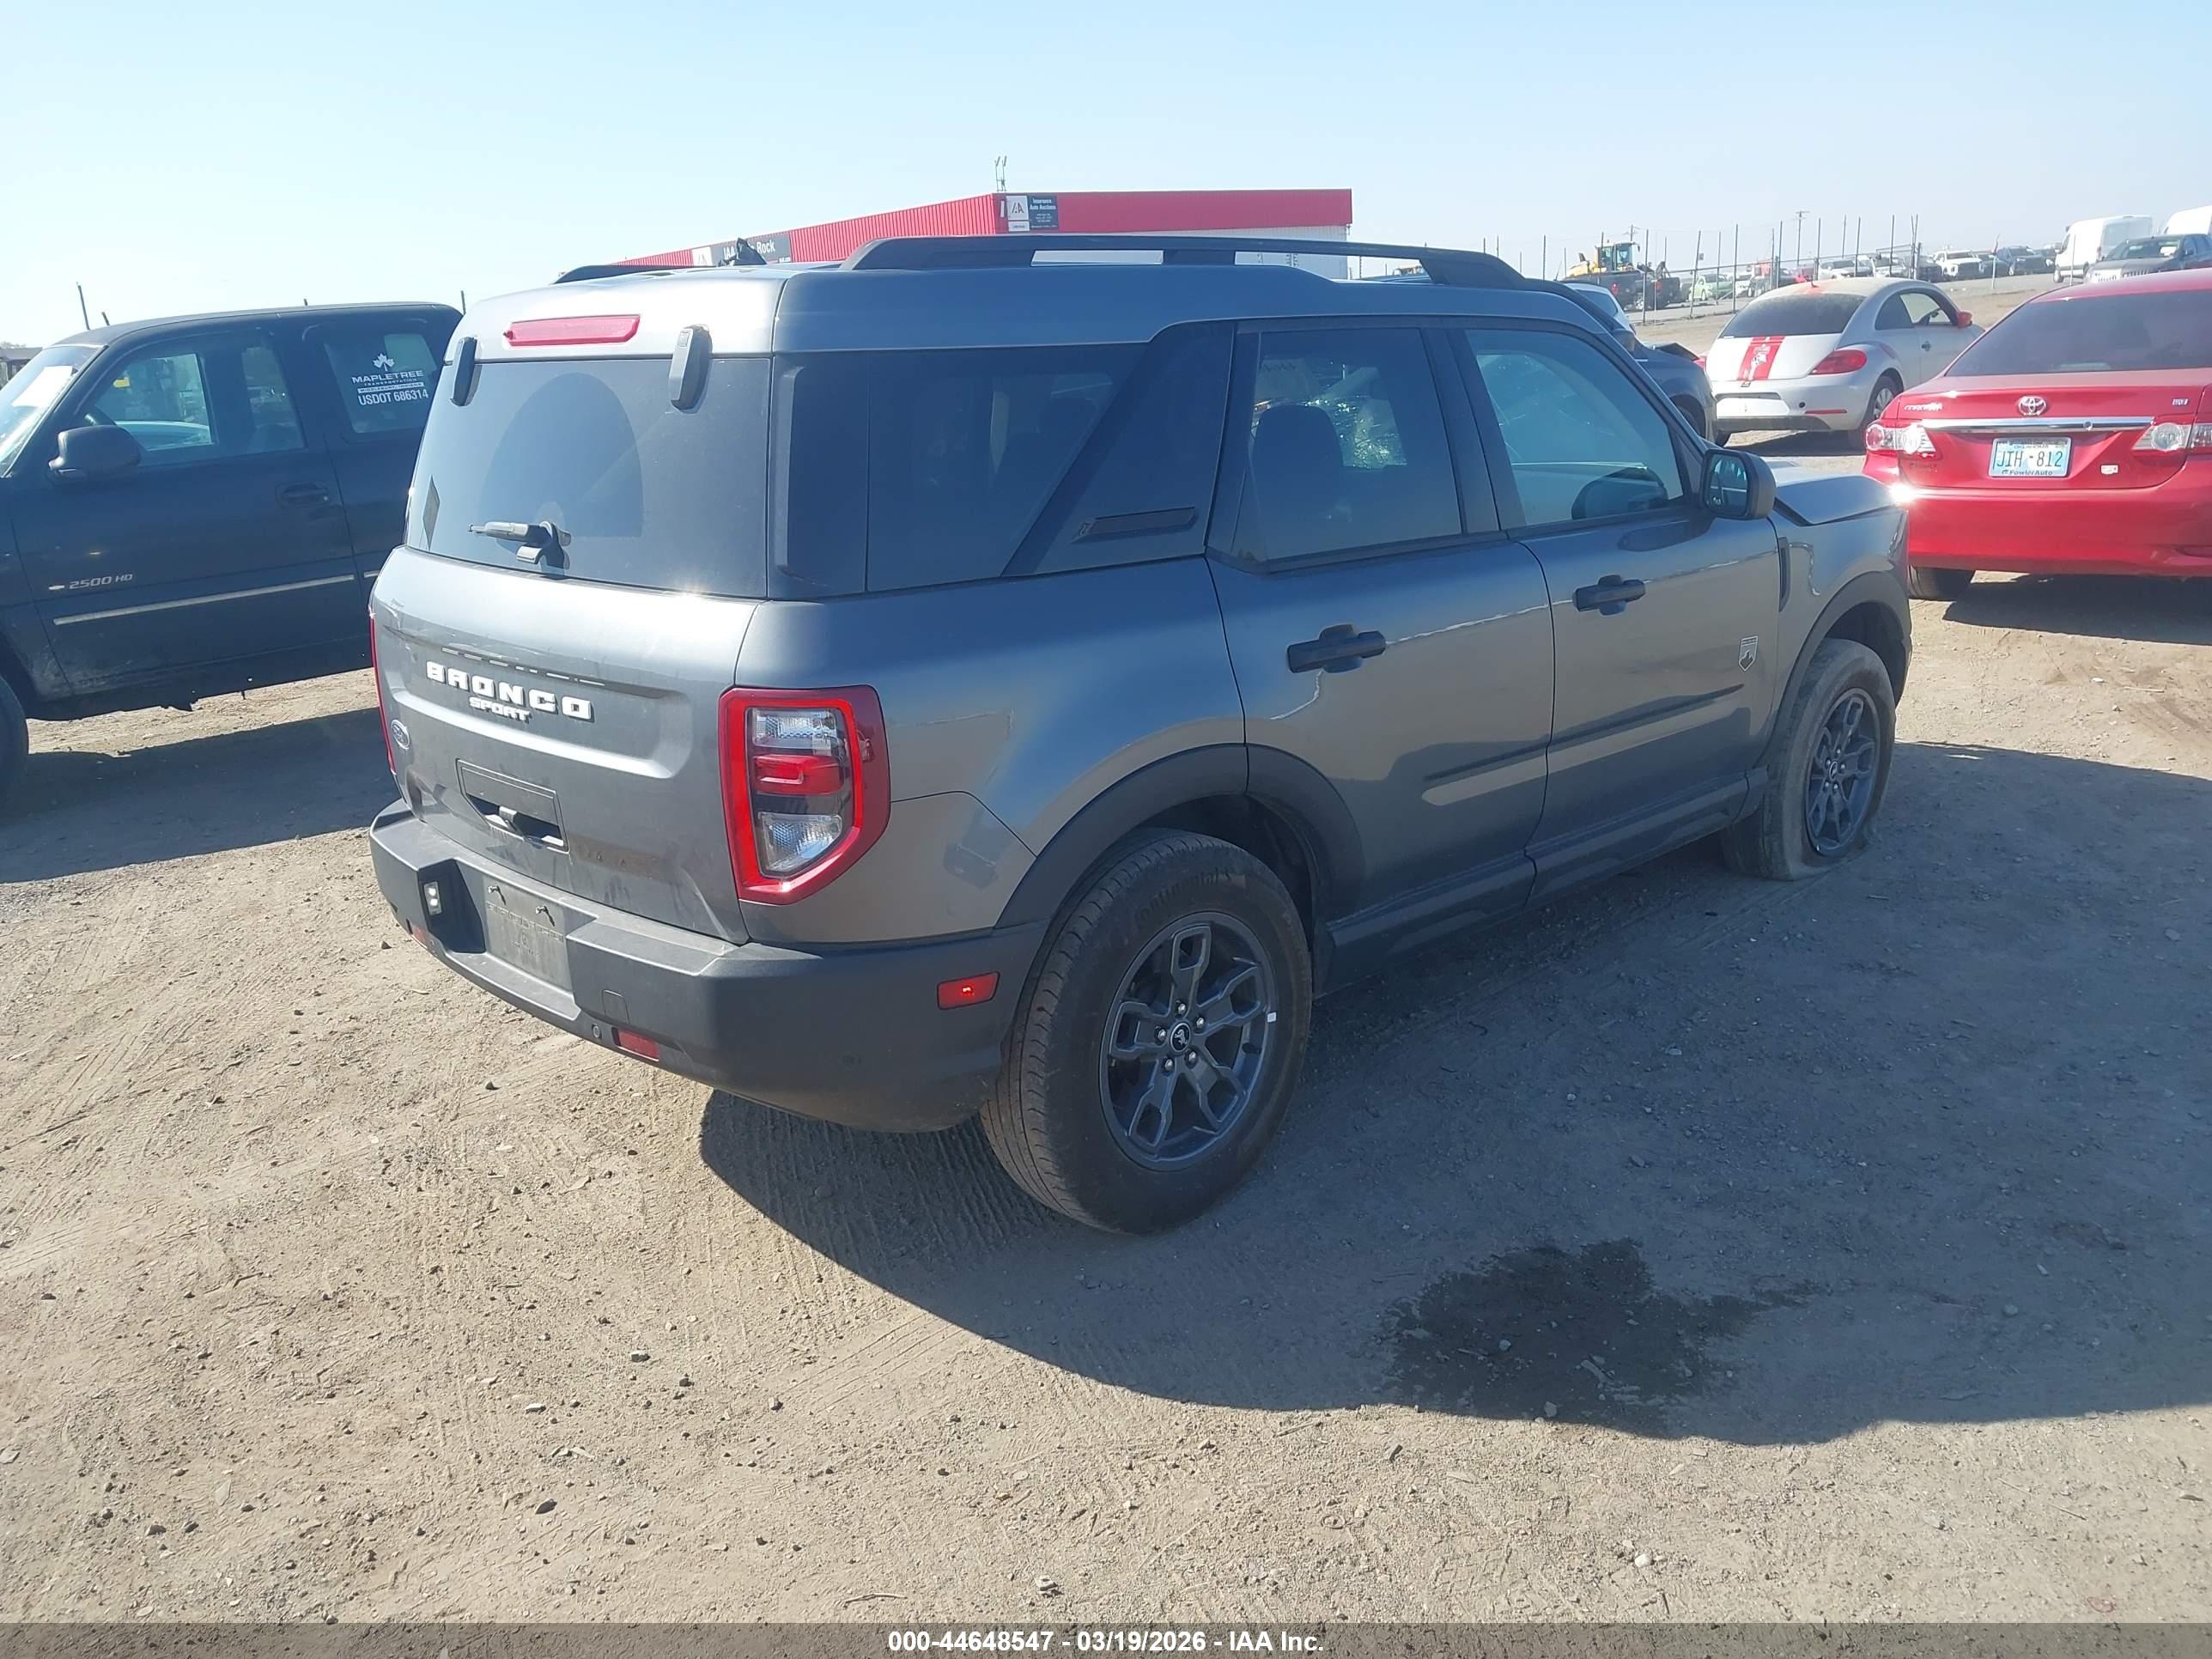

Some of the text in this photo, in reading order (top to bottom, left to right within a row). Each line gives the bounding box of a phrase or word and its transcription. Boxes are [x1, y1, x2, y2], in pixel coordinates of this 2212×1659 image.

[756, 240, 776, 254] Rock
[351, 370, 424, 383] MAPLETREE
[364, 378, 417, 386] TRANSPORTATION
[358, 389, 428, 405] USDOT 686314
[70, 574, 133, 589] 2500 HD
[427, 660, 592, 720] BRONCO
[469, 696, 532, 722] SPORT
